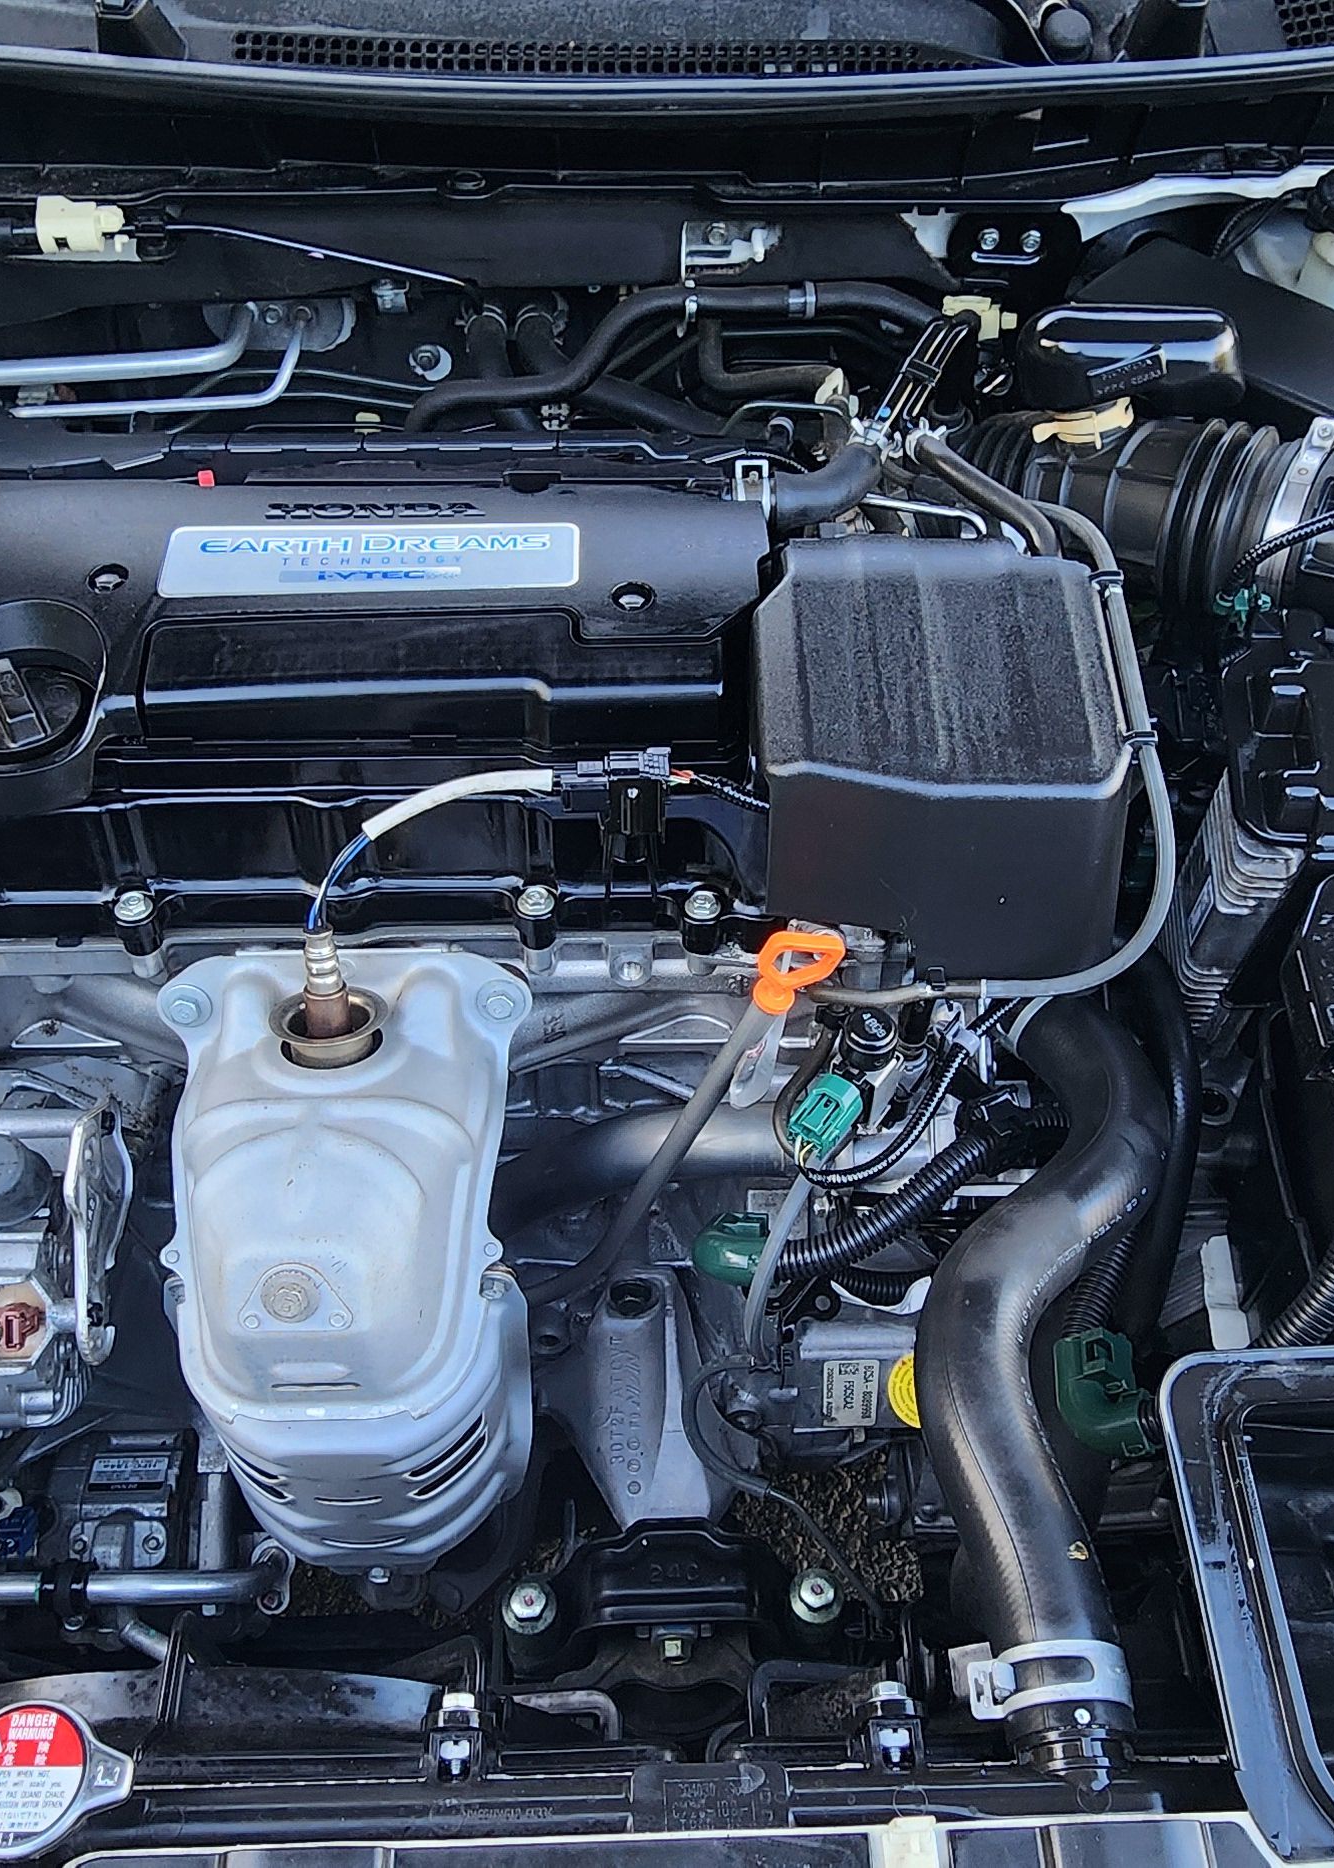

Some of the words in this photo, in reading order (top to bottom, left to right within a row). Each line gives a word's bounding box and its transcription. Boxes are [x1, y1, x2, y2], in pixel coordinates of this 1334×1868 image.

[264, 502, 486, 519] HONDA
[200, 535, 353, 554] EARTH
[362, 534, 551, 552] DREAMS
[281, 555, 463, 566] TECHNOLOGY
[317, 571, 425, 581] i-VTEC
[11, 1713, 57, 1727] DANGER
[8, 1728, 54, 1740] WARNUNG
